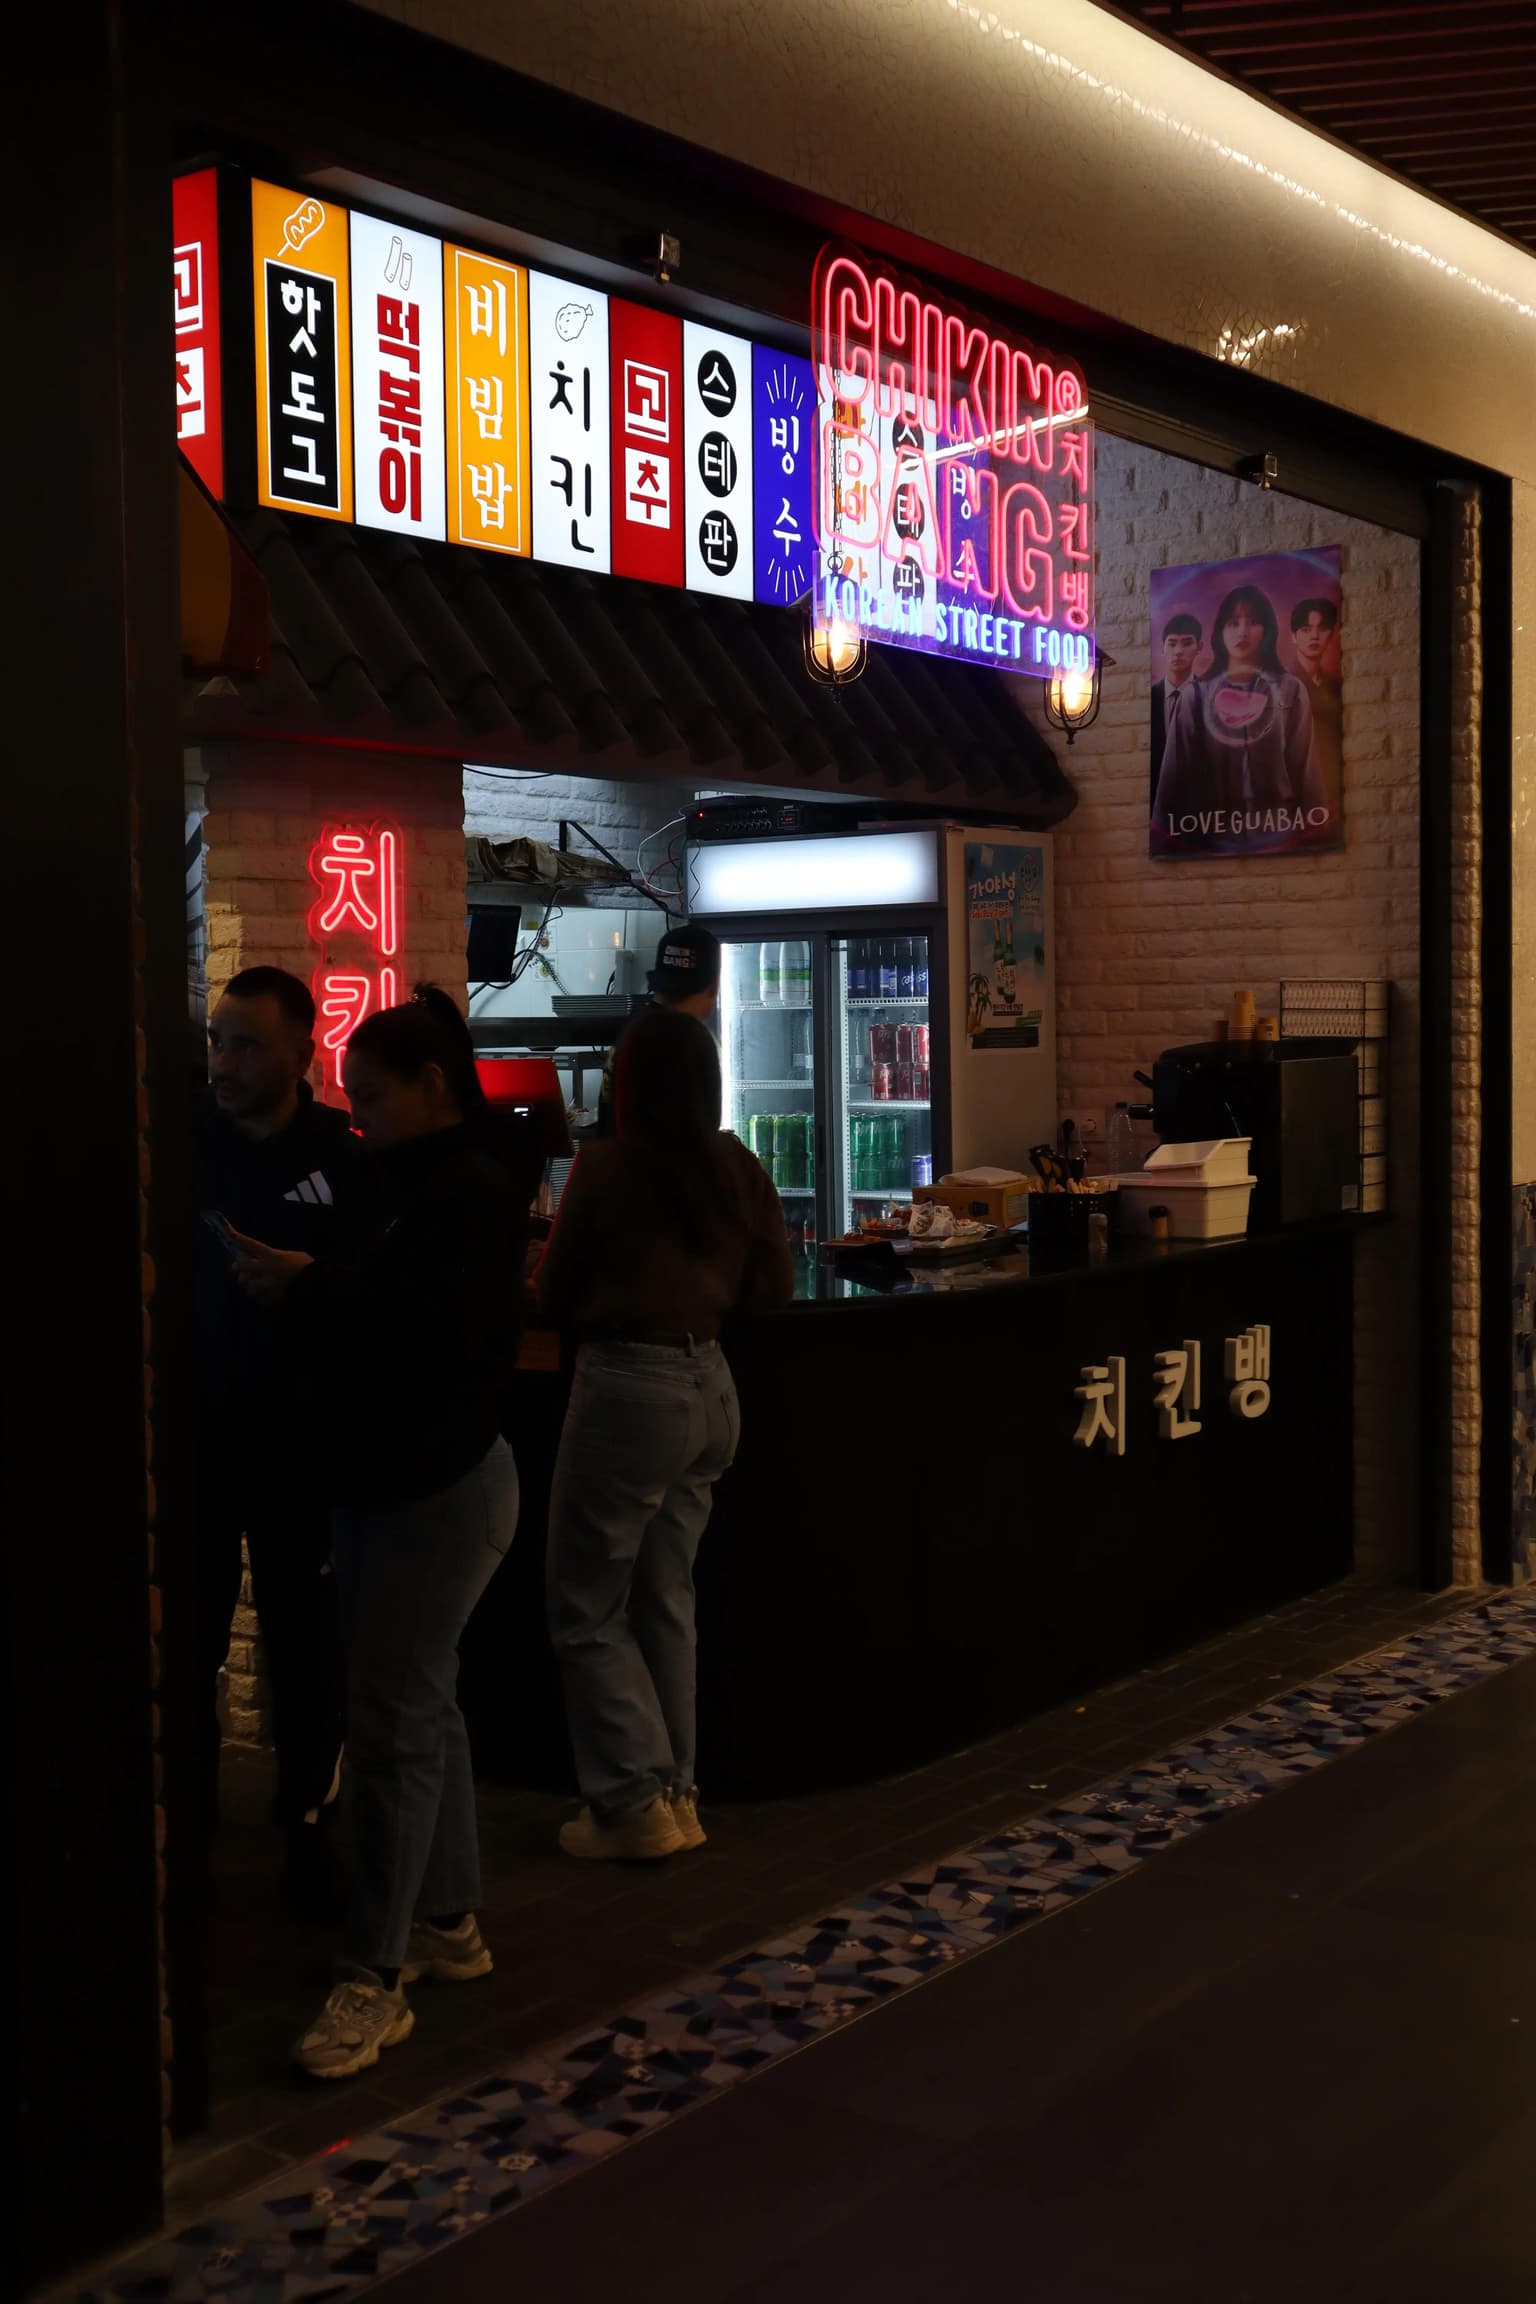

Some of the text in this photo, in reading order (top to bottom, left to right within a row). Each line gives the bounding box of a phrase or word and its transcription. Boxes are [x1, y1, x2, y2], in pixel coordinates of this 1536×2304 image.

[281, 279, 326, 486] 핫도그
[376, 293, 422, 523] 떡볶이
[464, 279, 512, 531] 비빔밥
[548, 360, 596, 554] 치킨
[626, 363, 669, 525] 고추
[701, 357, 735, 569] 스테판
[770, 415, 803, 558] 빙수
[823, 419, 1054, 623] BANG
[825, 575, 1090, 675] KOREAN STREET FOOD
